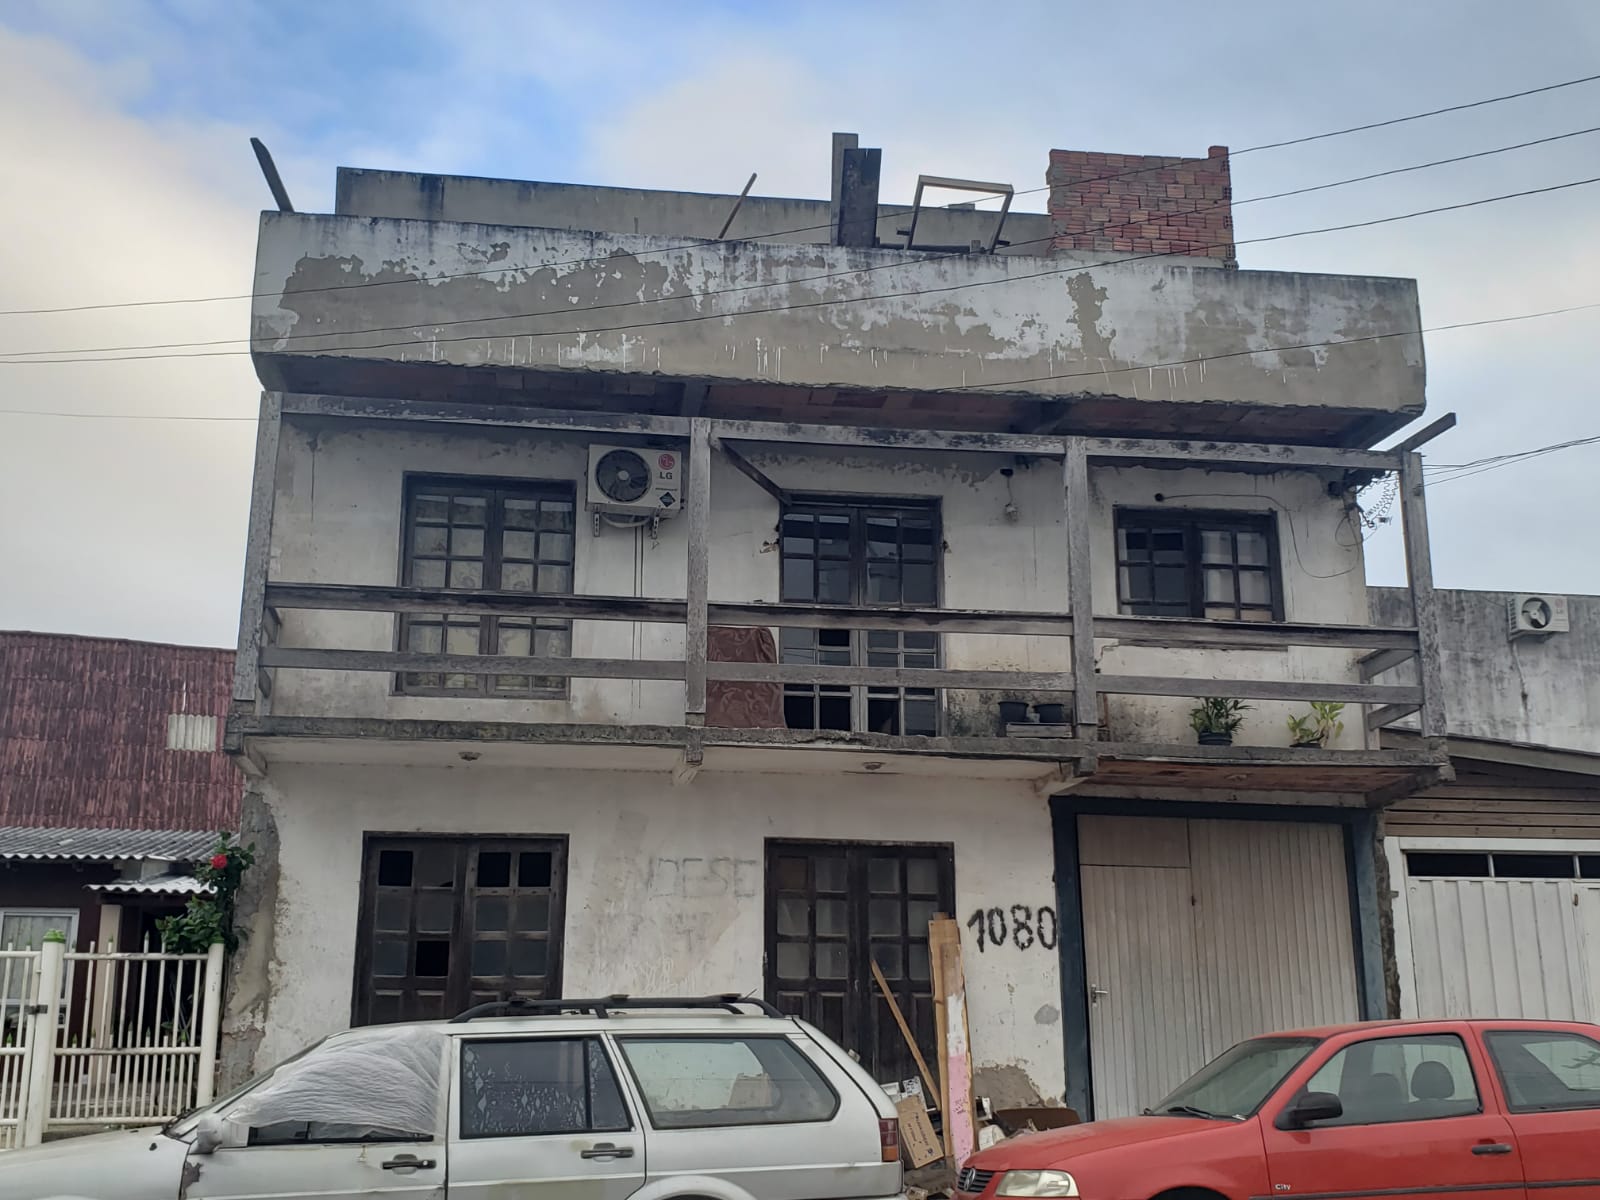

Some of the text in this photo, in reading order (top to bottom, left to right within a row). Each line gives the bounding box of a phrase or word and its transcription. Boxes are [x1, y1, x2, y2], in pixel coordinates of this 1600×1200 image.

[659, 472, 673, 480] LG
[967, 904, 1057, 953] 1080
[1275, 1183, 1291, 1191] City
